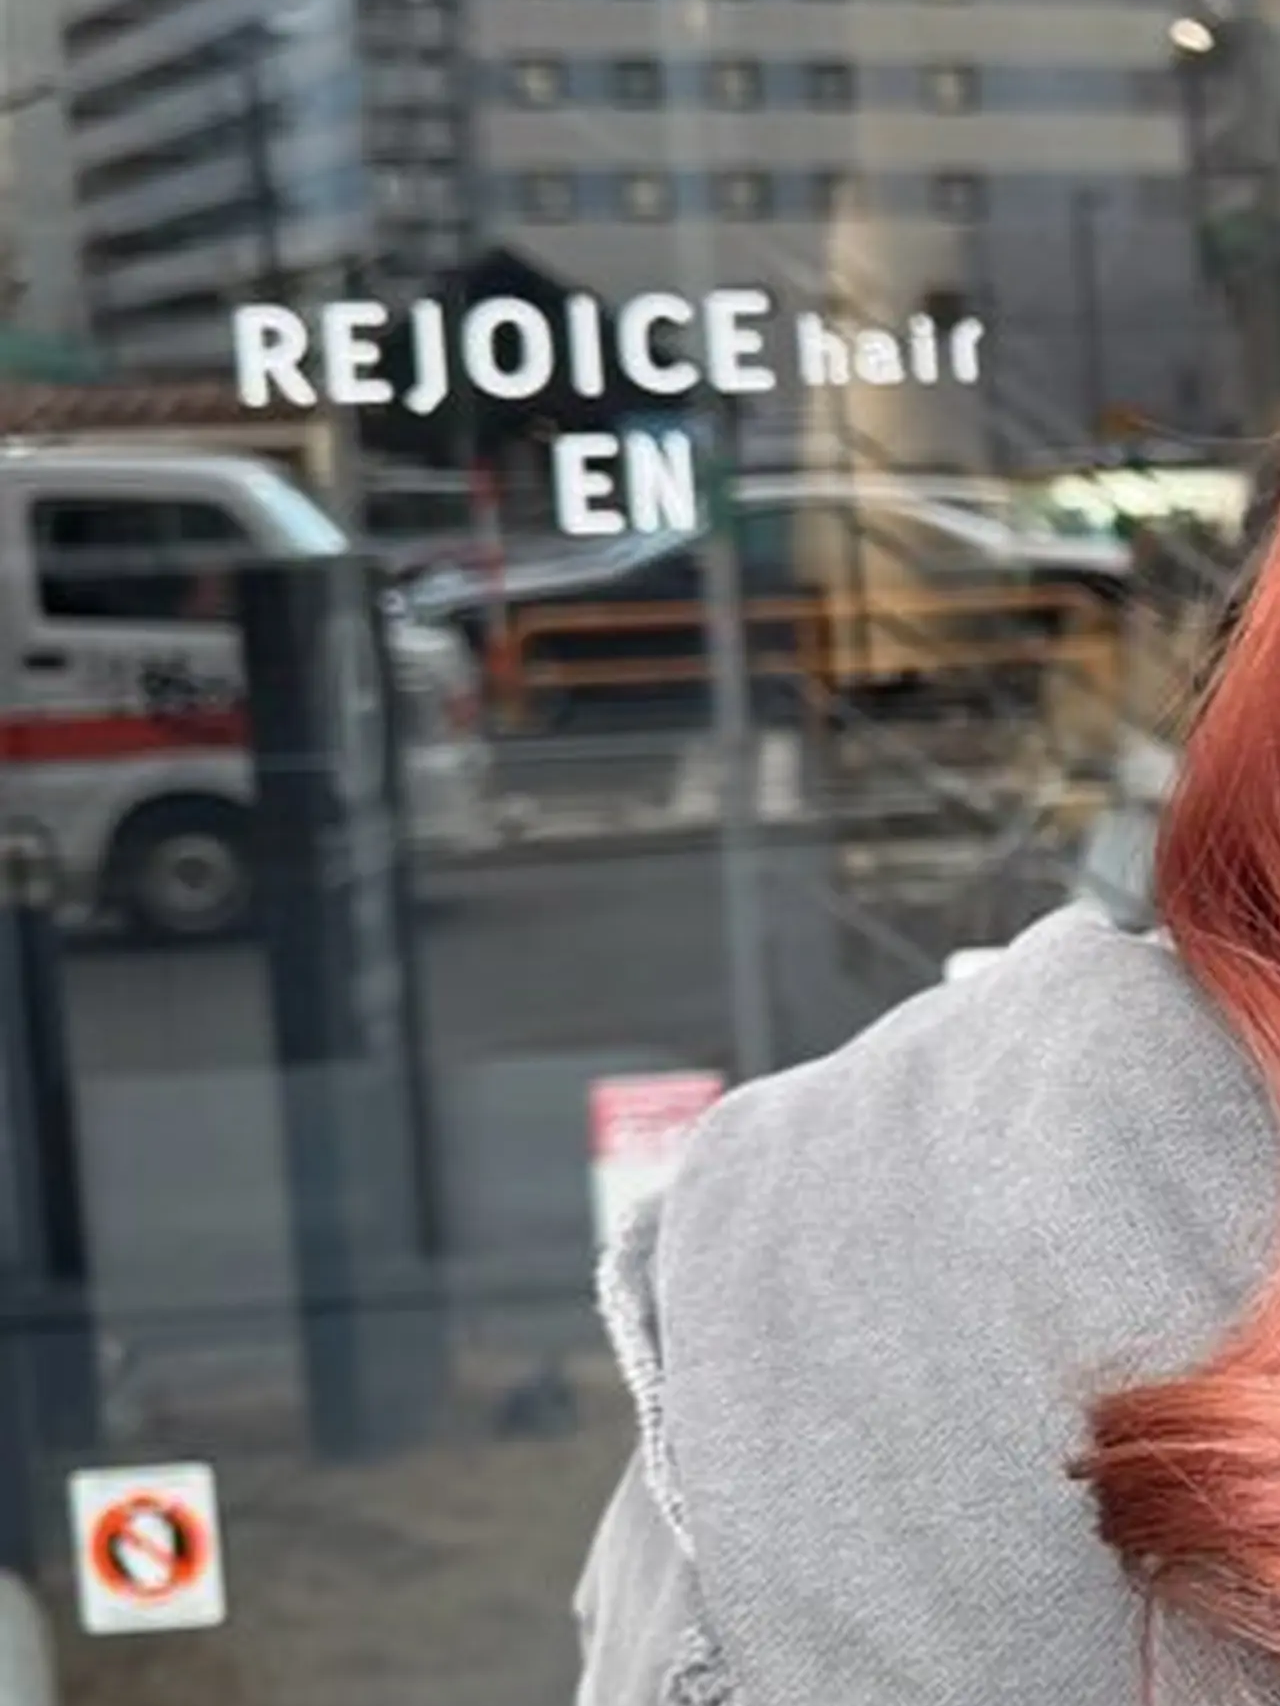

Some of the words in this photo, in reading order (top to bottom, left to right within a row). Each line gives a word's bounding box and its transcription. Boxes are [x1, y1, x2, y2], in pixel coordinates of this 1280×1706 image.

[233, 288, 777, 415] REJOICE
[796, 310, 985, 388] hair
[553, 430, 699, 536] EN
